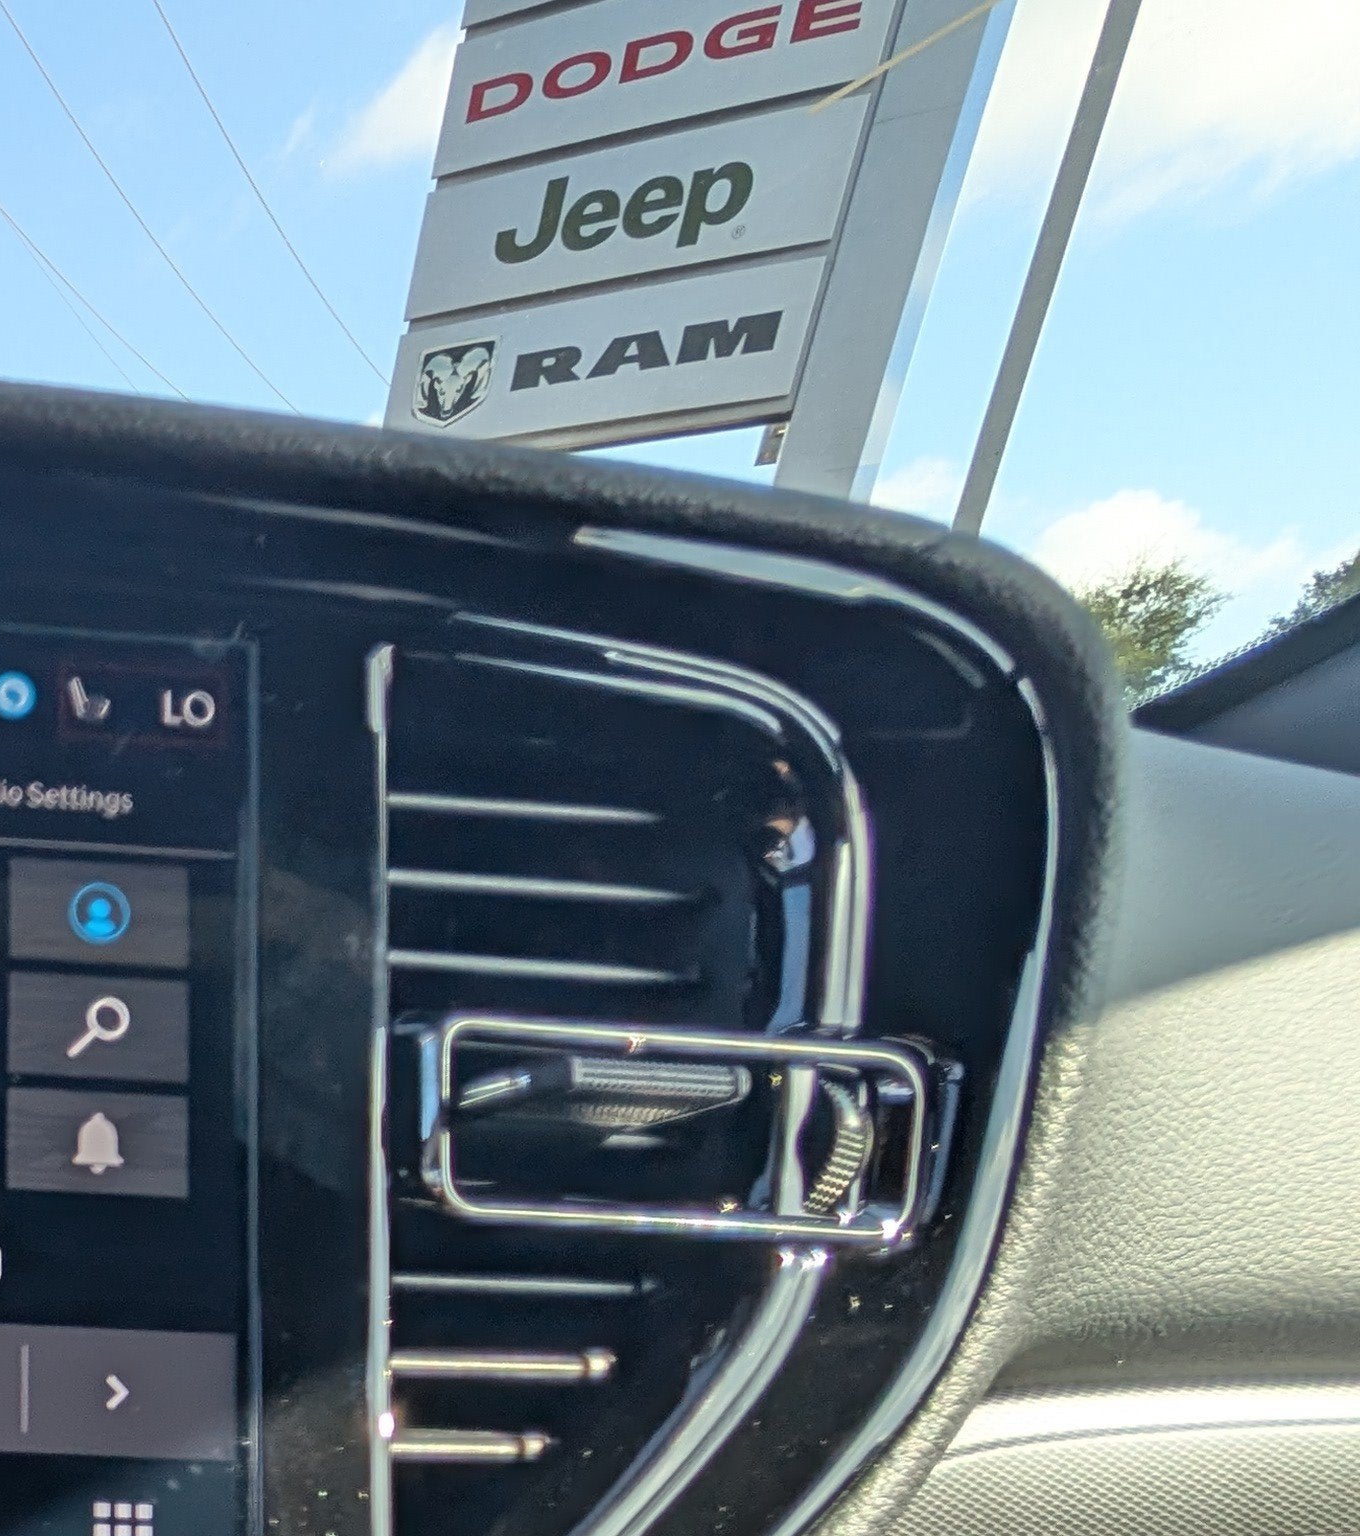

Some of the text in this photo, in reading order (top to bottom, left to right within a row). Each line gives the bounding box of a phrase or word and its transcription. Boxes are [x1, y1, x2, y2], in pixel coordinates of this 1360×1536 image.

[464, 0, 862, 125] DODGE
[493, 157, 754, 265] Jeep
[510, 310, 784, 393] RAM
[162, 688, 216, 728] LO
[26, 780, 134, 819] Settings
